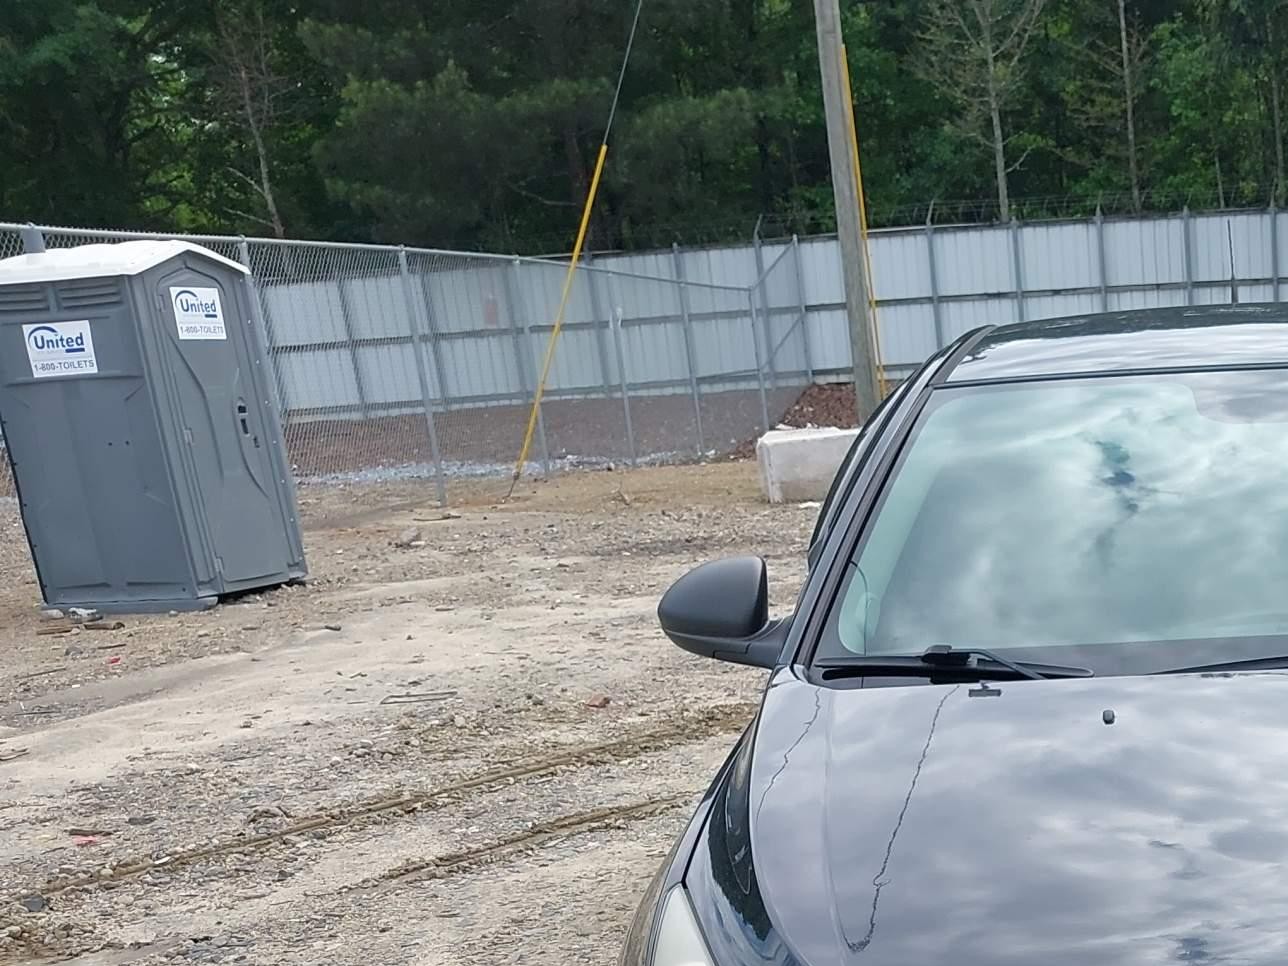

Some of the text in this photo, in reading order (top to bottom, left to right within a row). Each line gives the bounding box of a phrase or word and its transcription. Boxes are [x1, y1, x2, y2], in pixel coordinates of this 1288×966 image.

[179, 298, 217, 313] United
[33, 332, 85, 350] United
[34, 360, 95, 372] 1-800-TOILETS
